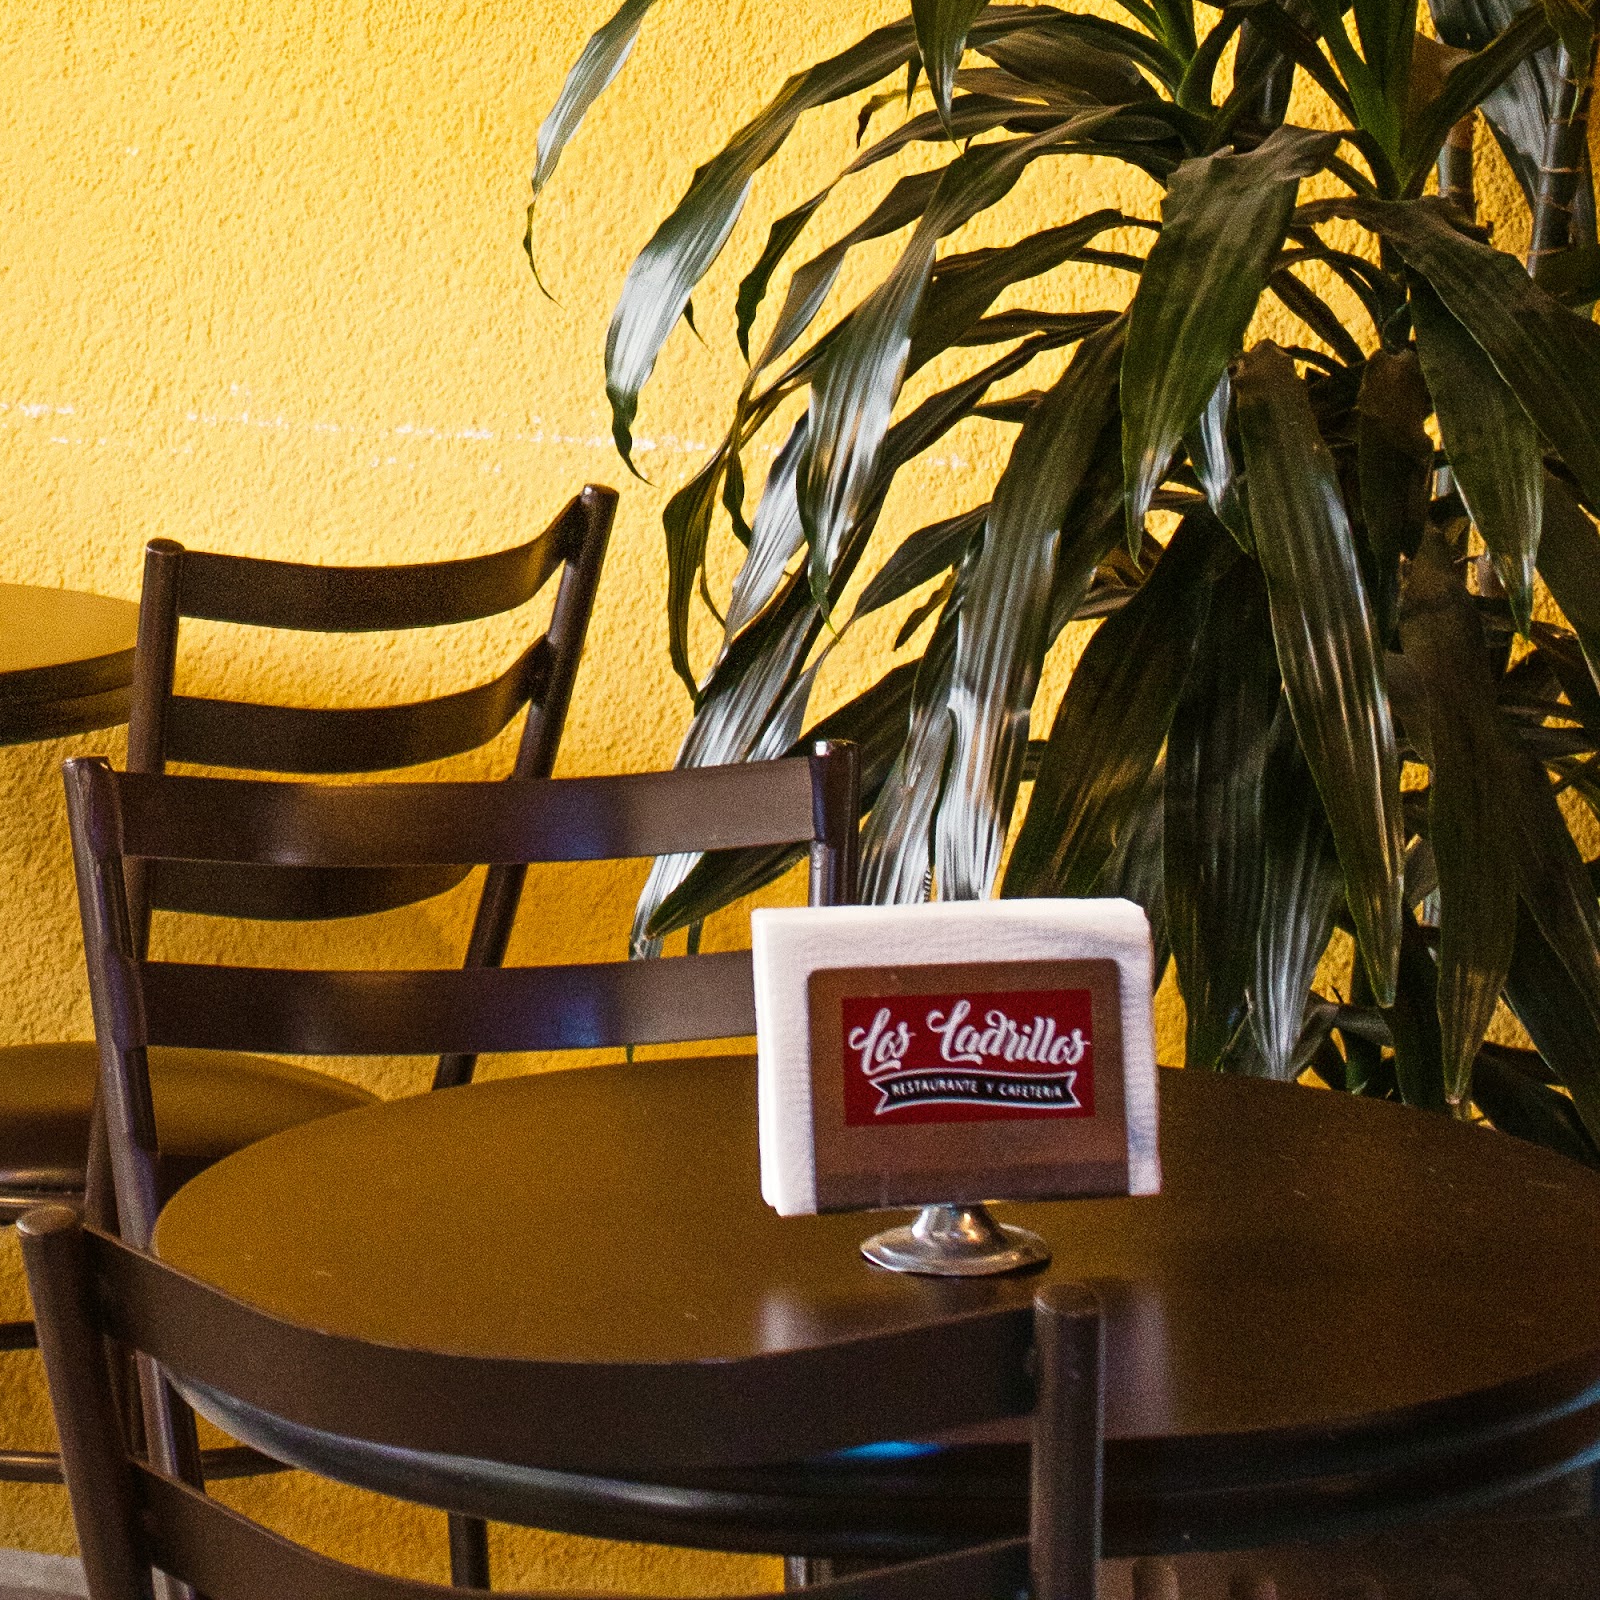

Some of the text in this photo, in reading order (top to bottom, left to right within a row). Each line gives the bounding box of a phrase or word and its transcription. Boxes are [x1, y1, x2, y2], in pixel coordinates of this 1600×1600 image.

[848, 999, 1091, 1077] Los Ladrillos
[890, 1078, 979, 1096] RESTAURANTE
